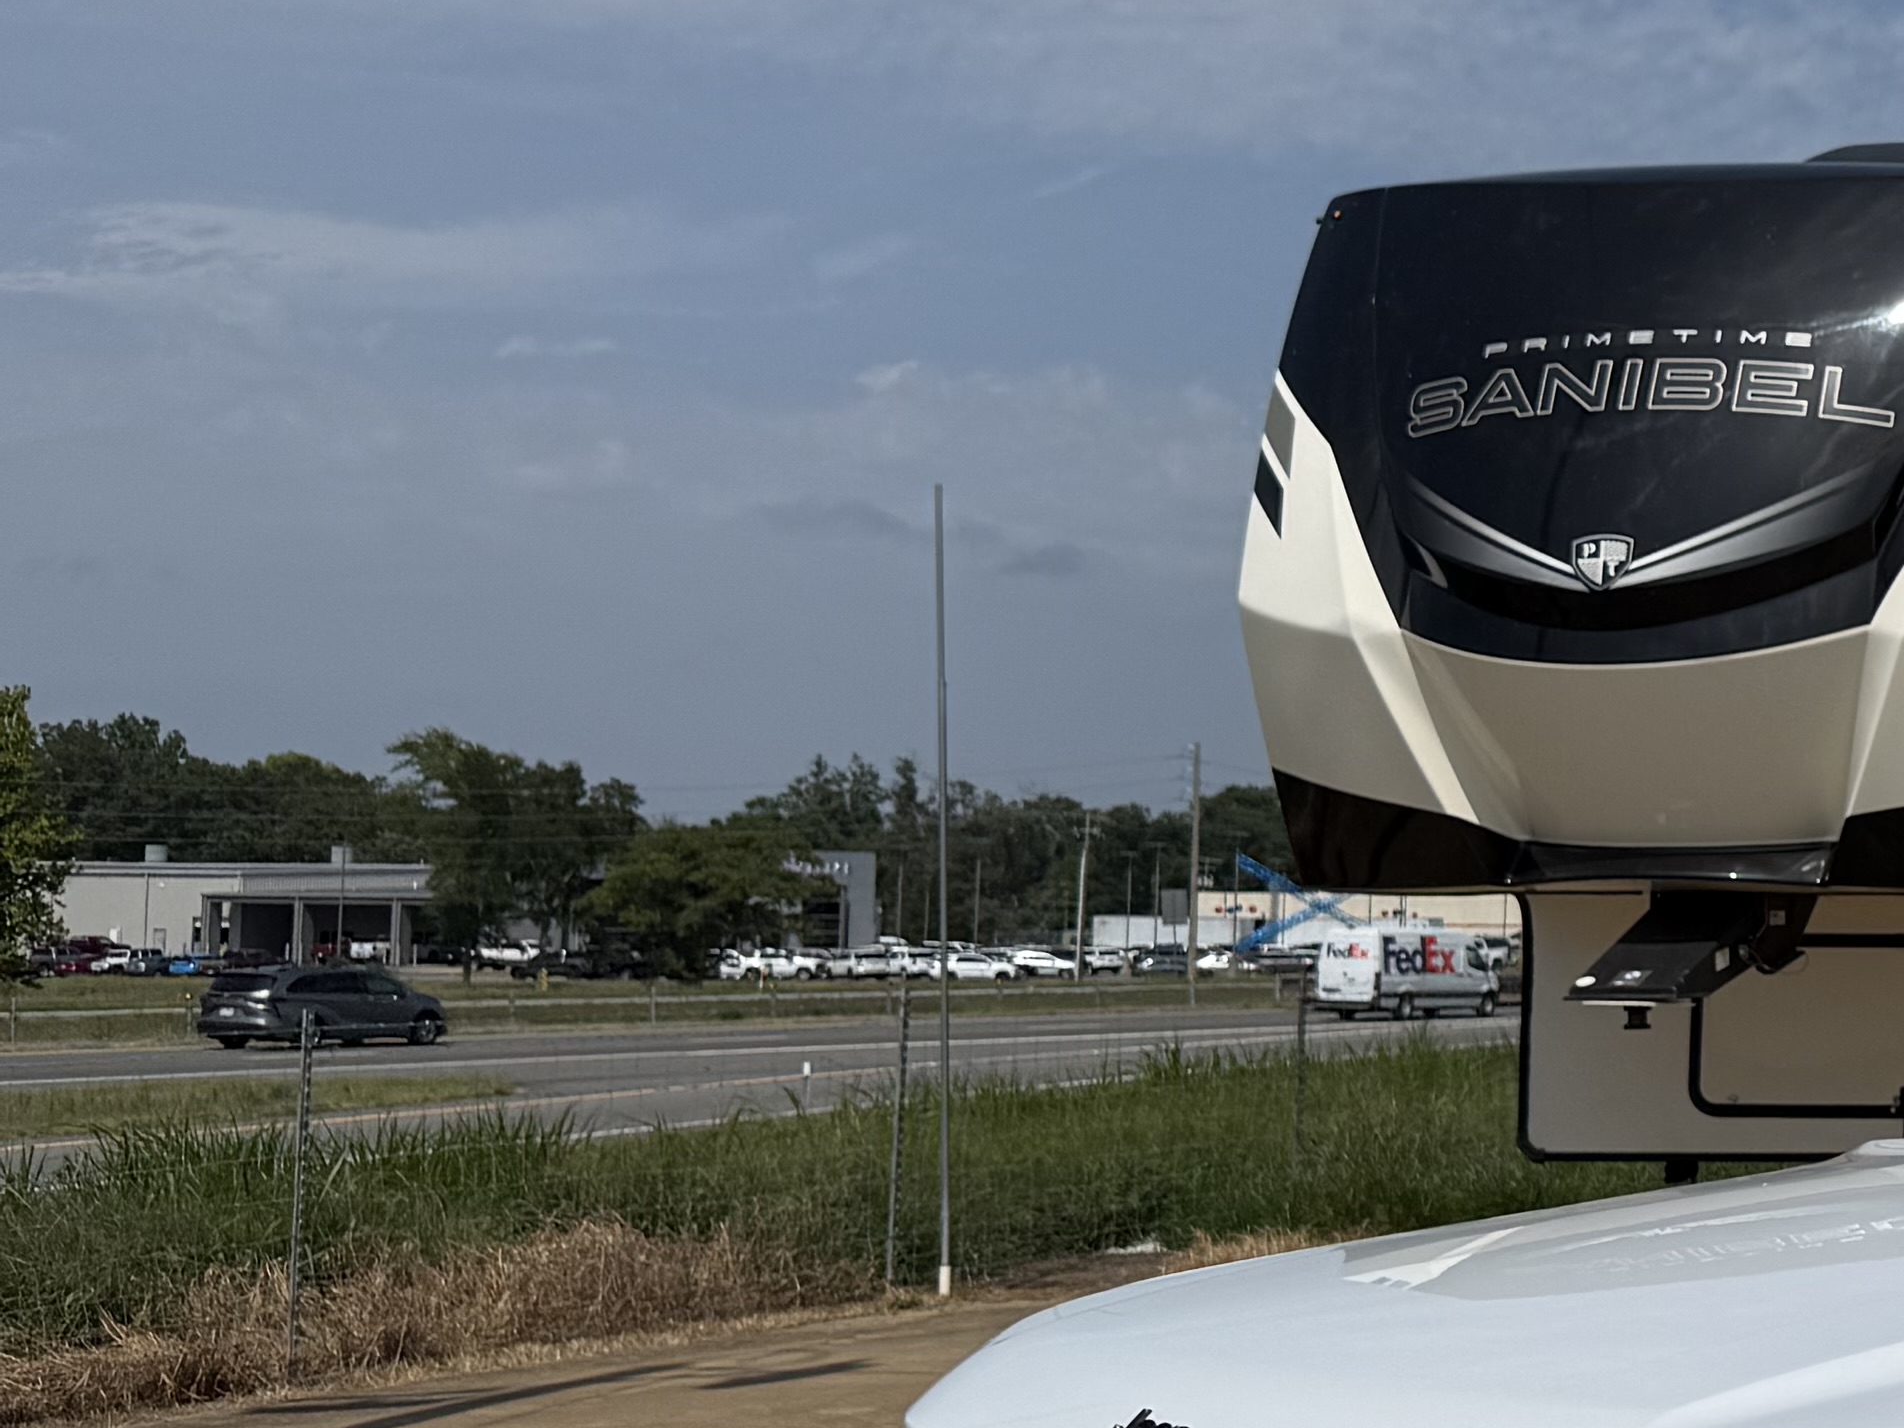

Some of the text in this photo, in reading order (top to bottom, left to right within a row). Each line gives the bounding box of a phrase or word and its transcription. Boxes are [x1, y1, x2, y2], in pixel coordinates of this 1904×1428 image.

[1482, 328, 1813, 359] PRIMETIME
[1407, 357, 1895, 438] SANIBEL
[1326, 942, 1369, 960] FedEx
[1383, 935, 1456, 975] FedEx
